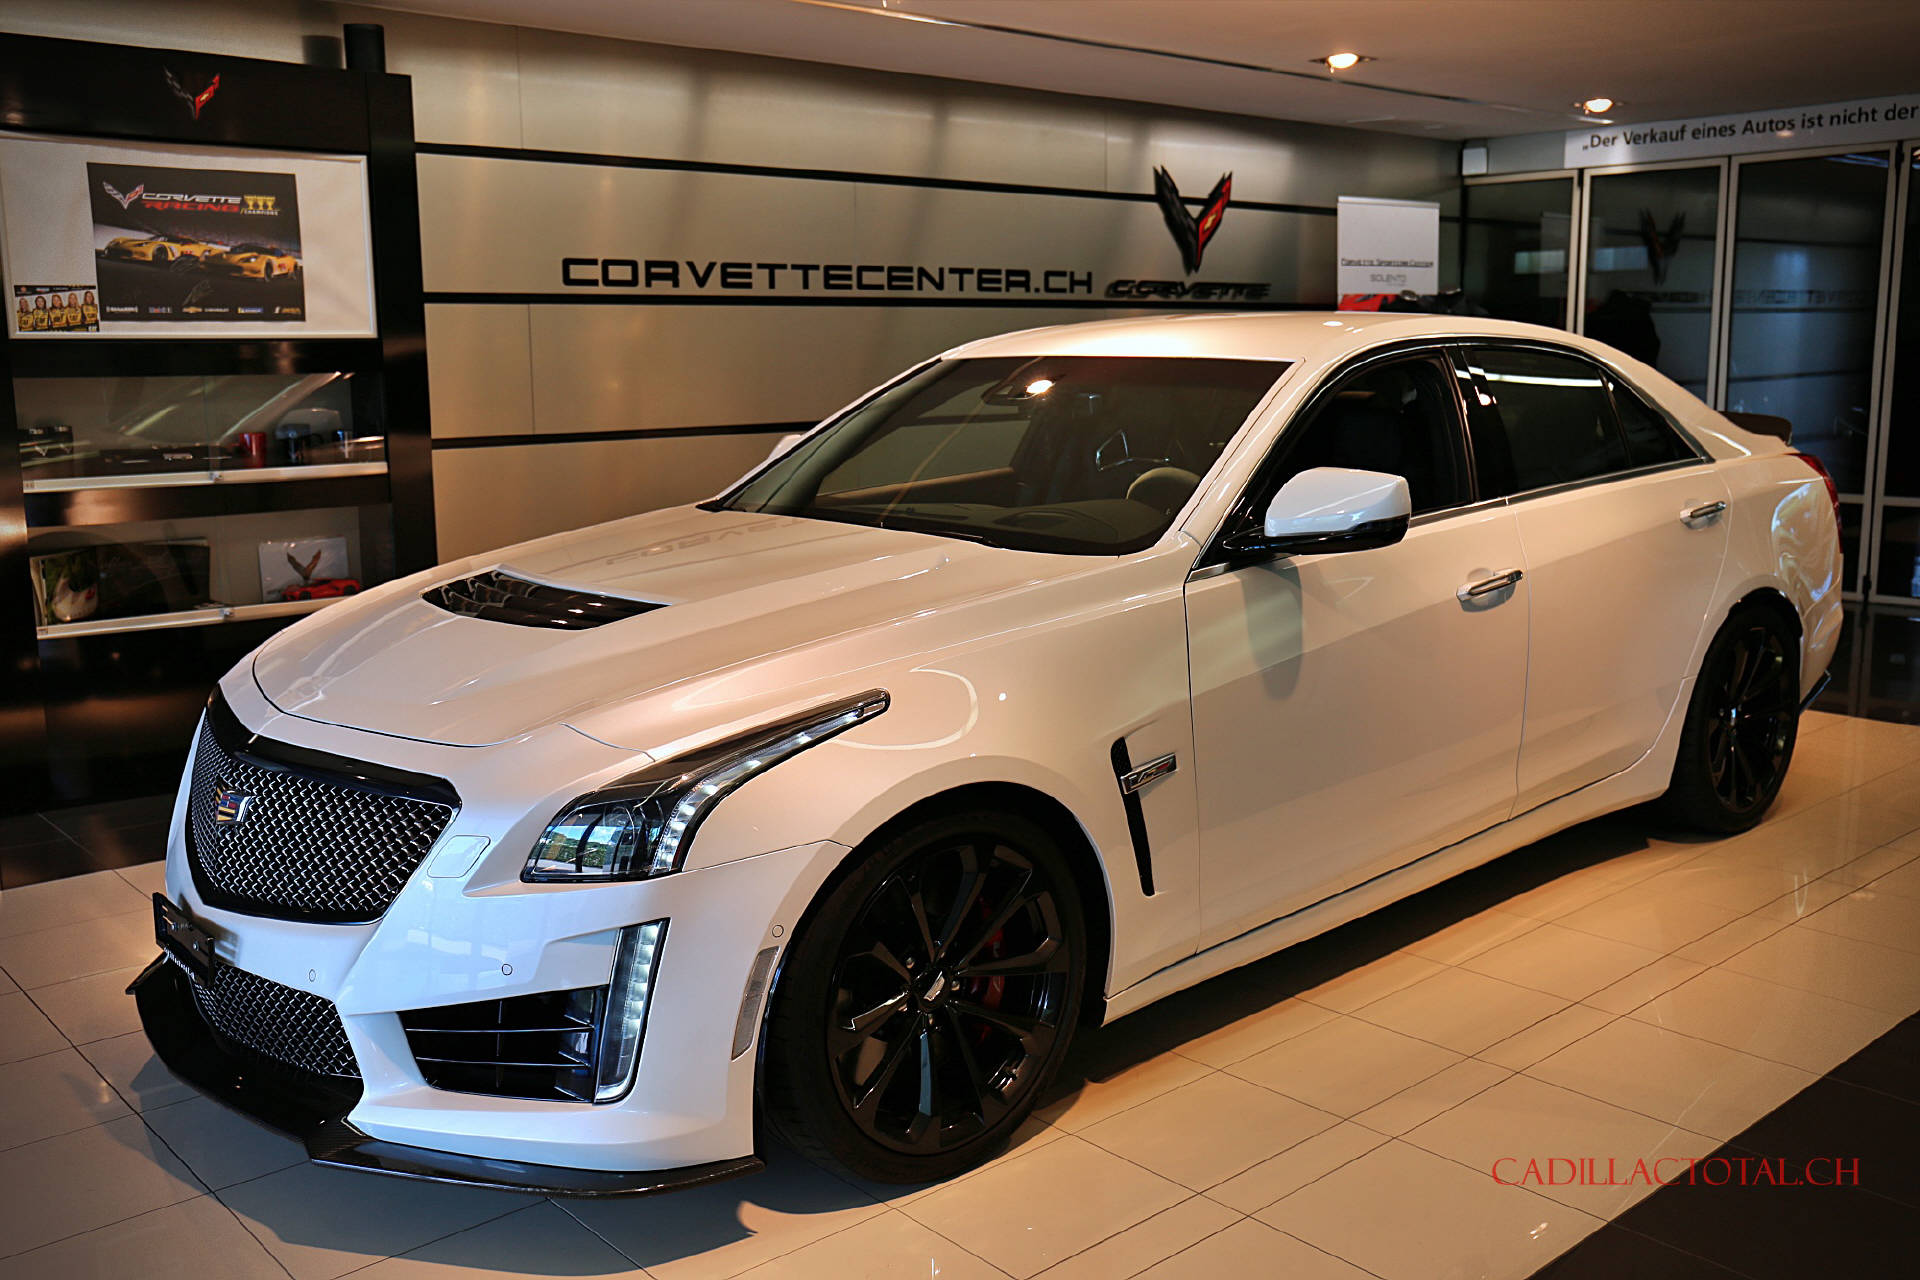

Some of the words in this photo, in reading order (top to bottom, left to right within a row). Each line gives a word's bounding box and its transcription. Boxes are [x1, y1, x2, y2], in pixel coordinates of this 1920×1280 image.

[1623, 125, 1687, 146] Verkauf
[1691, 126, 1736, 141] eines
[1741, 115, 1796, 136] Autos
[1801, 112, 1824, 130] ist
[1829, 107, 1878, 127] nicht
[1884, 102, 1919, 121] der
[142, 192, 242, 204] CORVETTE
[142, 200, 240, 213] RACING
[562, 257, 1093, 294] CORVETTECENTER.CH
[1108, 280, 1272, 298] CORVETTE
